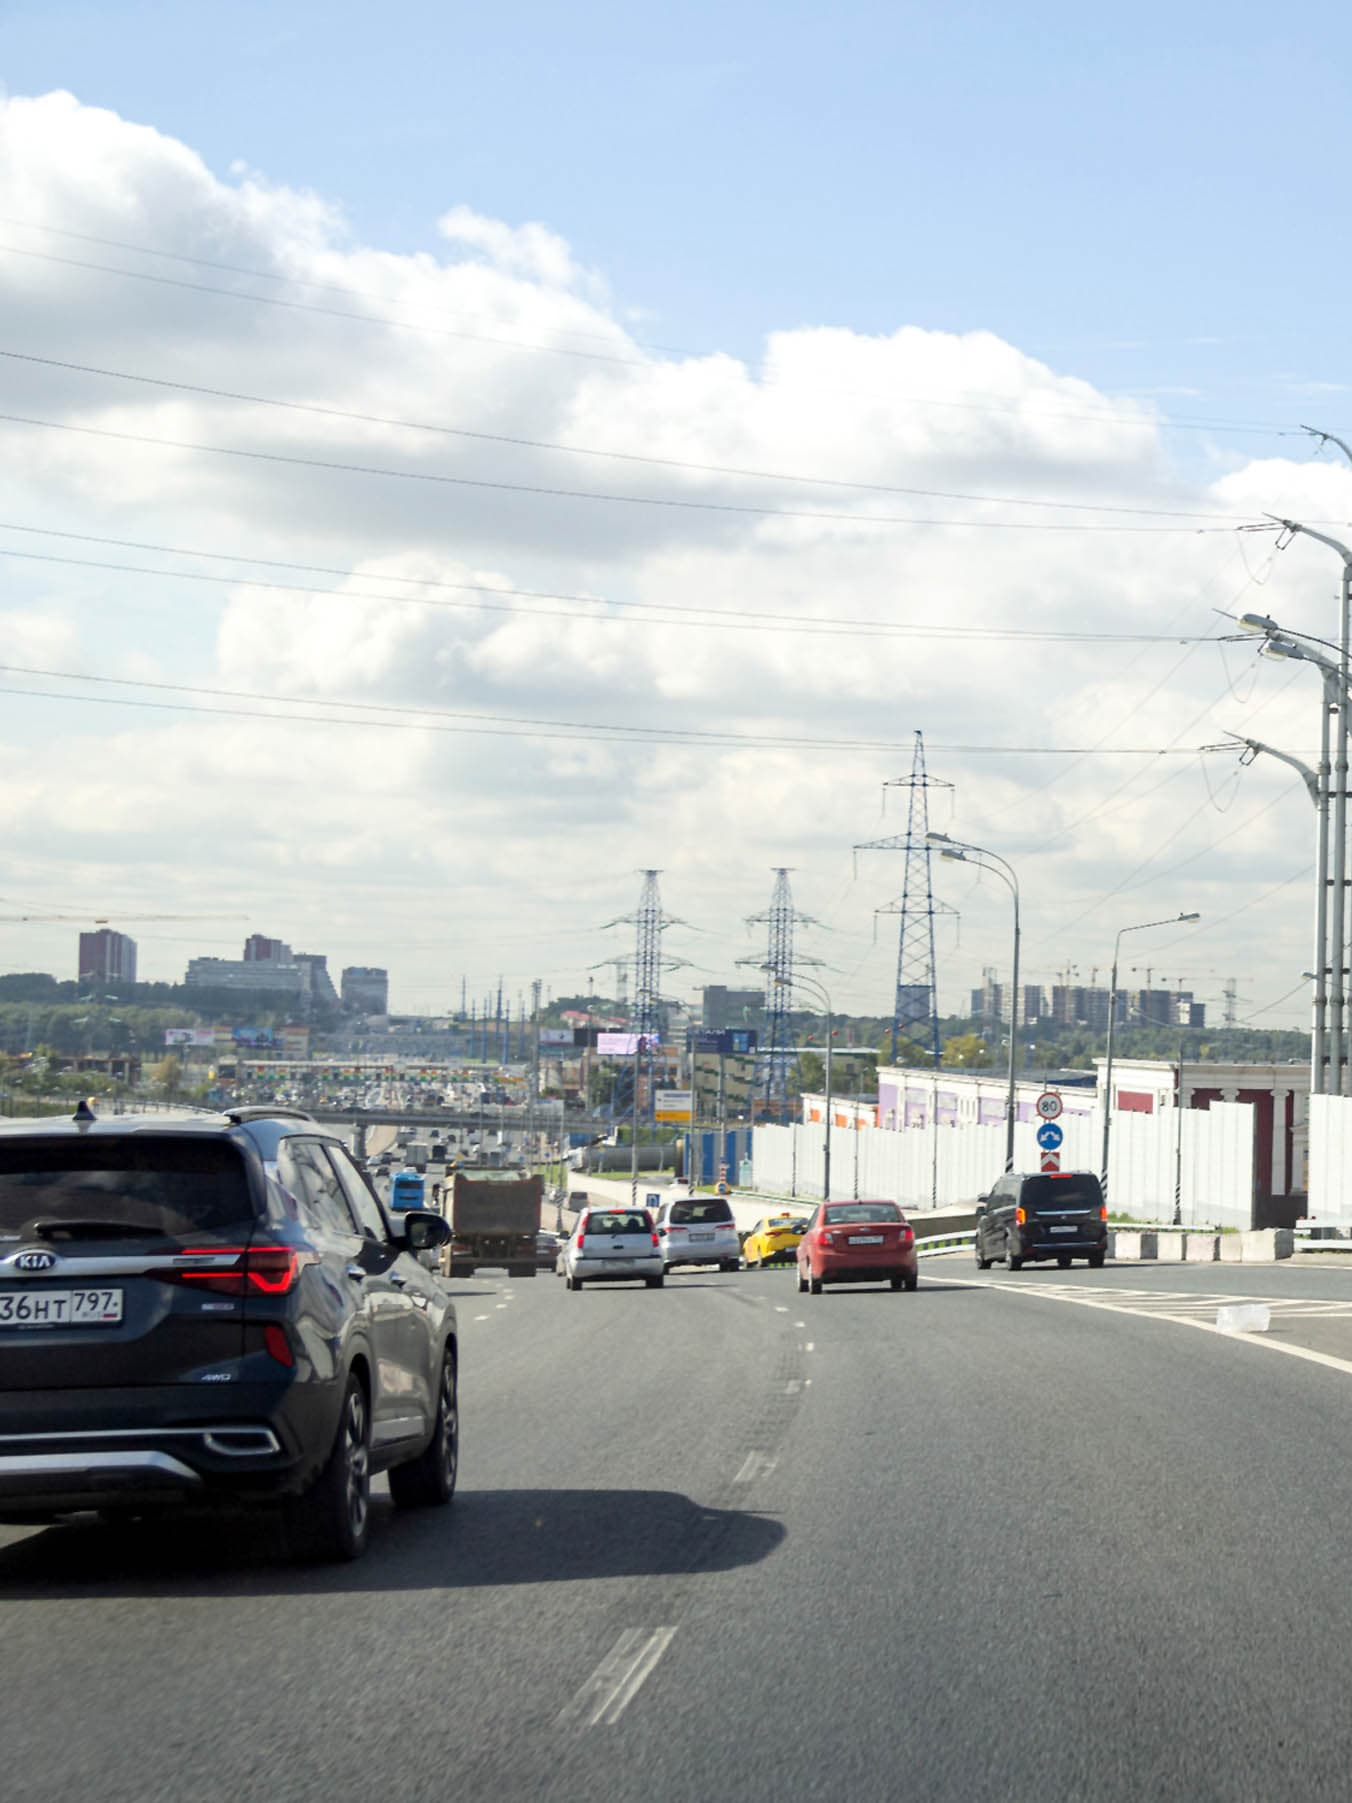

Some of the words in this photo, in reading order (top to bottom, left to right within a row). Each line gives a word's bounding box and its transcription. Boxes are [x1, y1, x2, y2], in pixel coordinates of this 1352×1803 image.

[1042, 1101, 1058, 1112] 80
[20, 1255, 51, 1268] KIA
[74, 1291, 114, 1312] 797
